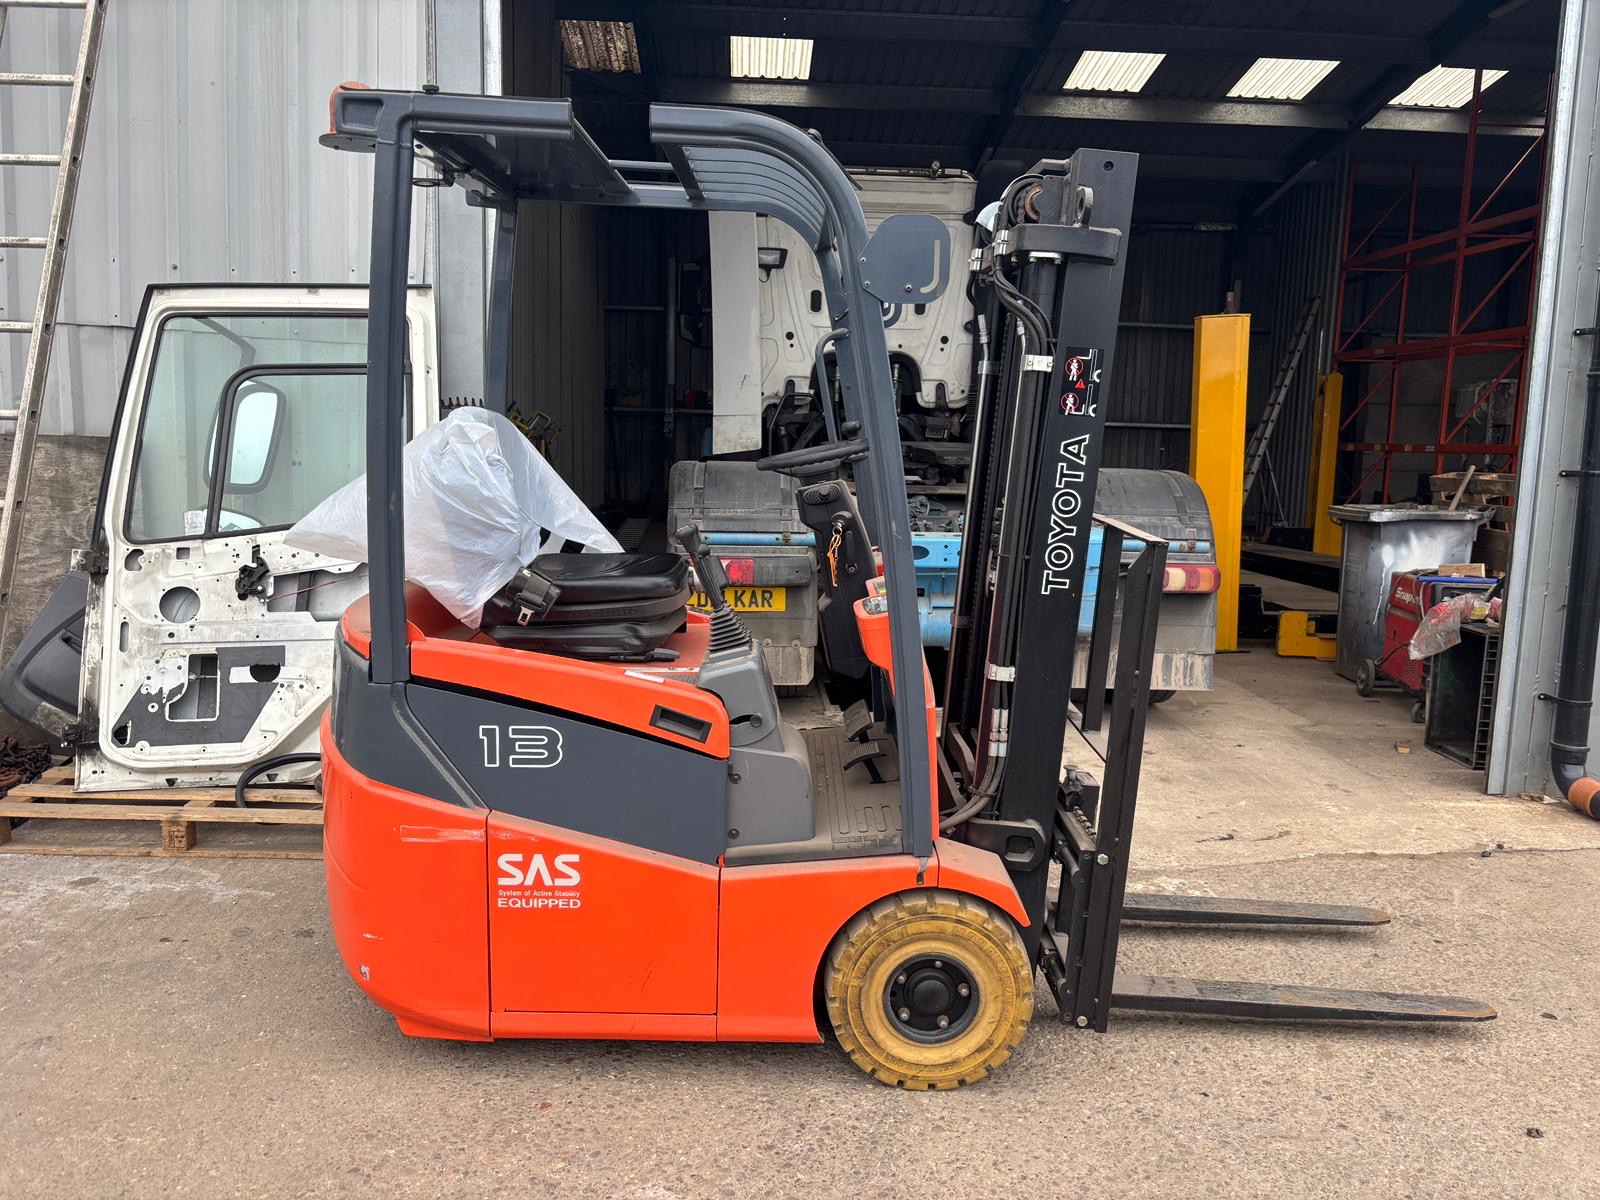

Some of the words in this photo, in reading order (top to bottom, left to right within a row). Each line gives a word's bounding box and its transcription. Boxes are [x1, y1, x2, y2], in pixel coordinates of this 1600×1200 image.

[1041, 433, 1090, 595] TOYOTA
[734, 589, 774, 608] KAR
[479, 725, 563, 768] 13
[497, 853, 581, 887] SAS
[497, 897, 581, 909] EQUIPPED
[498, 889, 522, 898] System
[524, 889, 531, 897] of
[533, 889, 552, 897] Active
[554, 889, 580, 898] Stability
